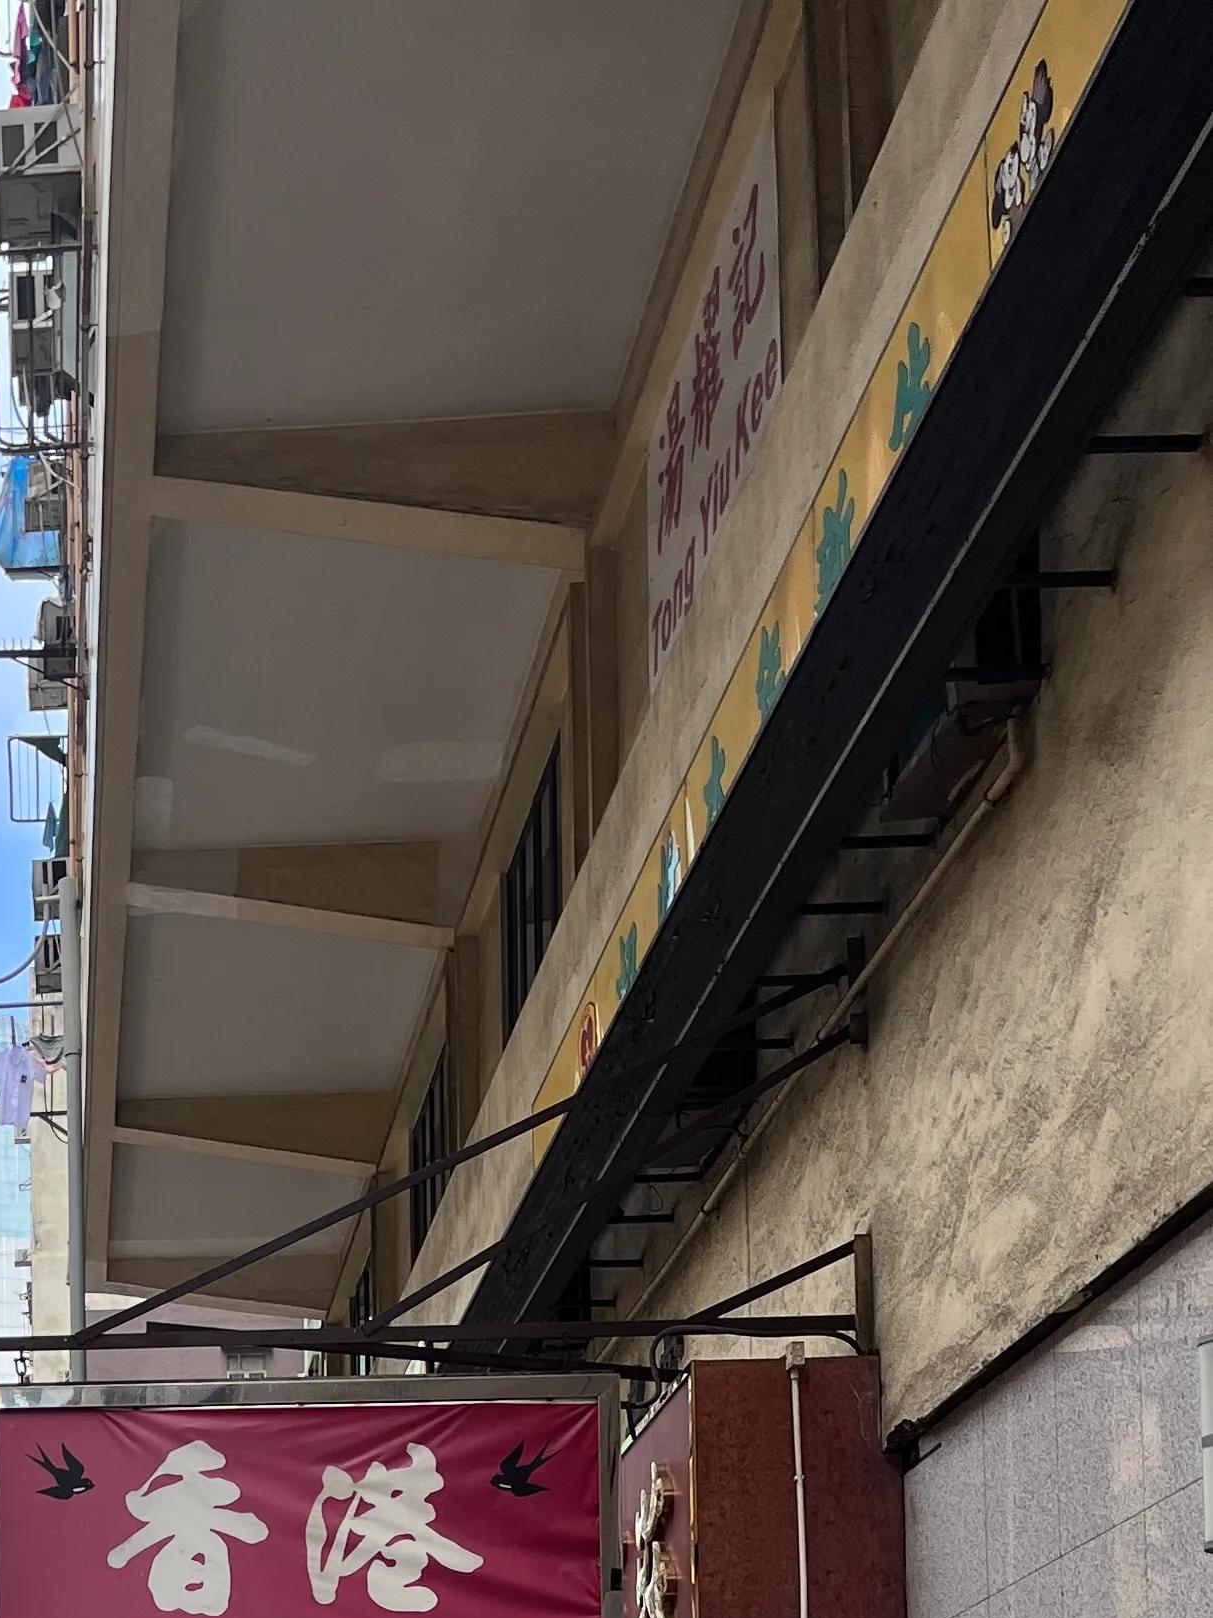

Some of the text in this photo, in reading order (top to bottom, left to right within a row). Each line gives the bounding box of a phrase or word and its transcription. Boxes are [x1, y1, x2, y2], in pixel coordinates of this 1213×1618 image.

[651, 338, 777, 677] Tong Yiu Kee
[107, 1440, 484, 1616] 香港
